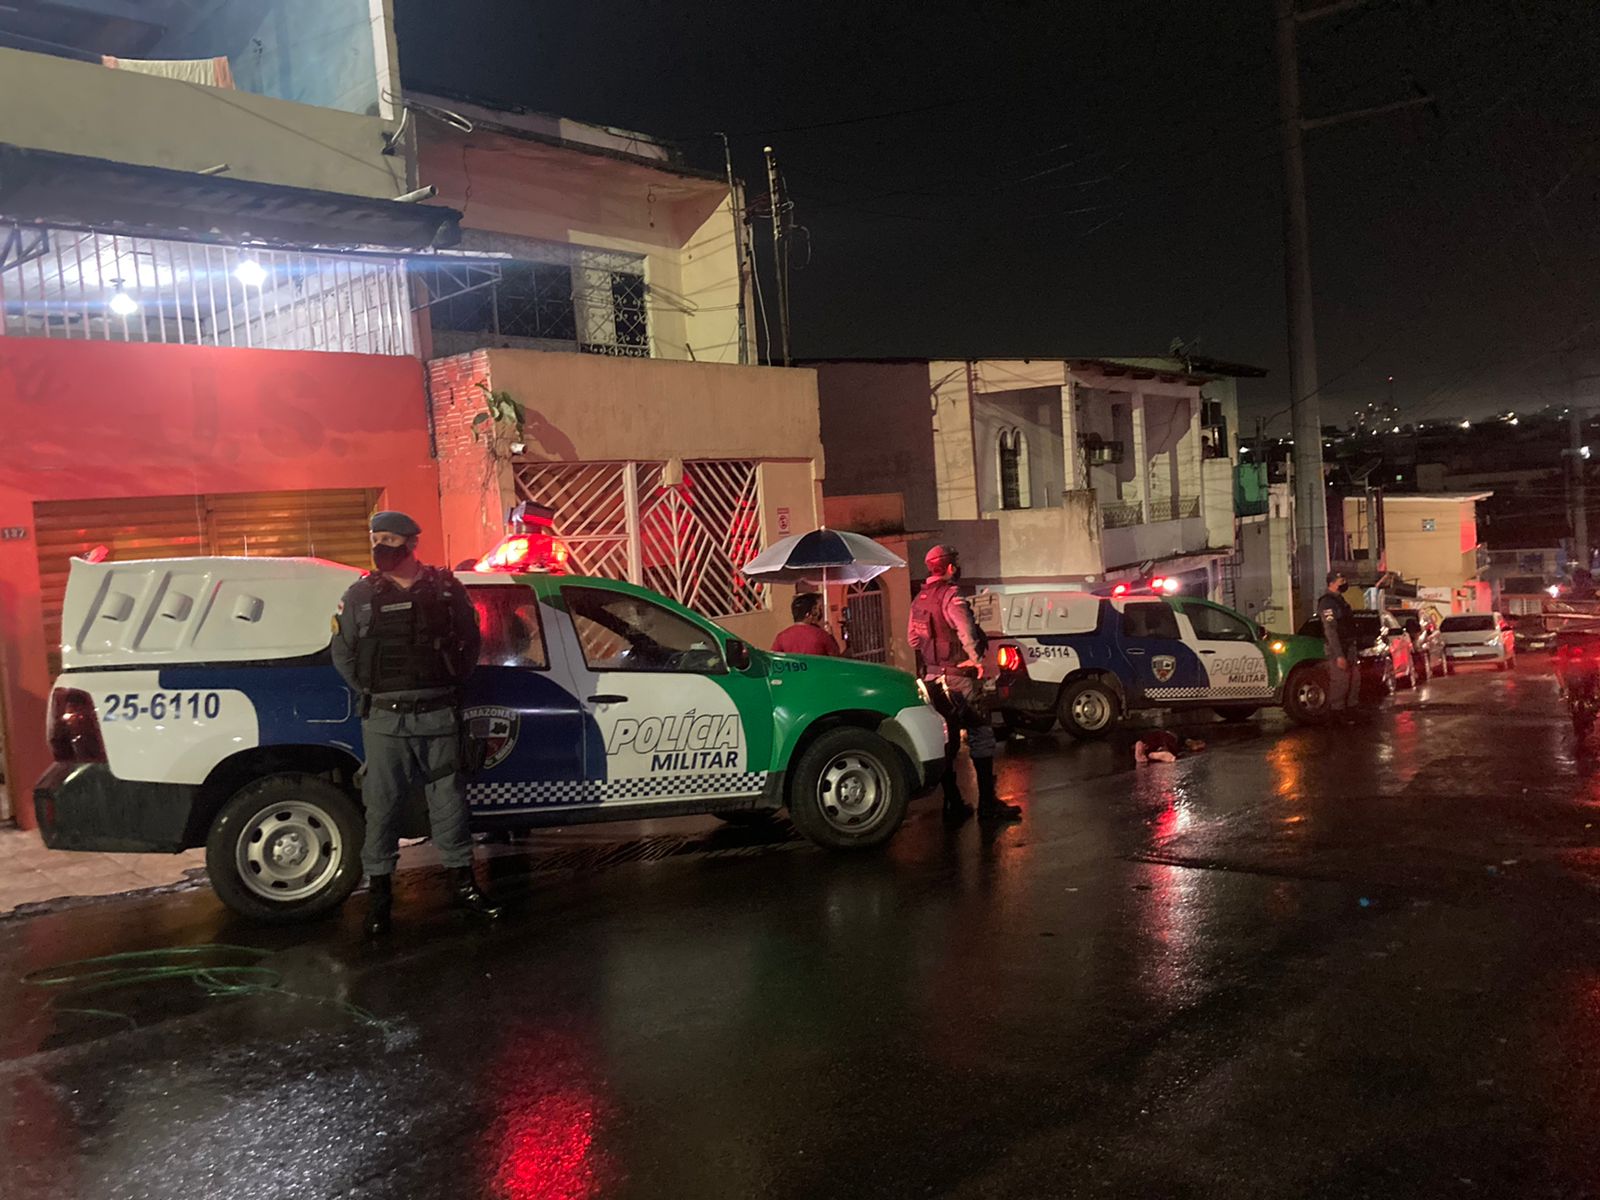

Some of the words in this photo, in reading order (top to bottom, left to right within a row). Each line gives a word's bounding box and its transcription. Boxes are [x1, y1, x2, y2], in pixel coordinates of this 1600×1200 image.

[1028, 646, 1070, 658] 25-6114
[785, 661, 808, 672] 190
[1210, 655, 1266, 676] POLÍCIA
[1228, 673, 1266, 683] MILITAR
[103, 692, 220, 721] 25-6110
[463, 707, 517, 721] AMAZONAS
[607, 708, 739, 755] POLÍCIA
[651, 750, 739, 772] MILITAR
